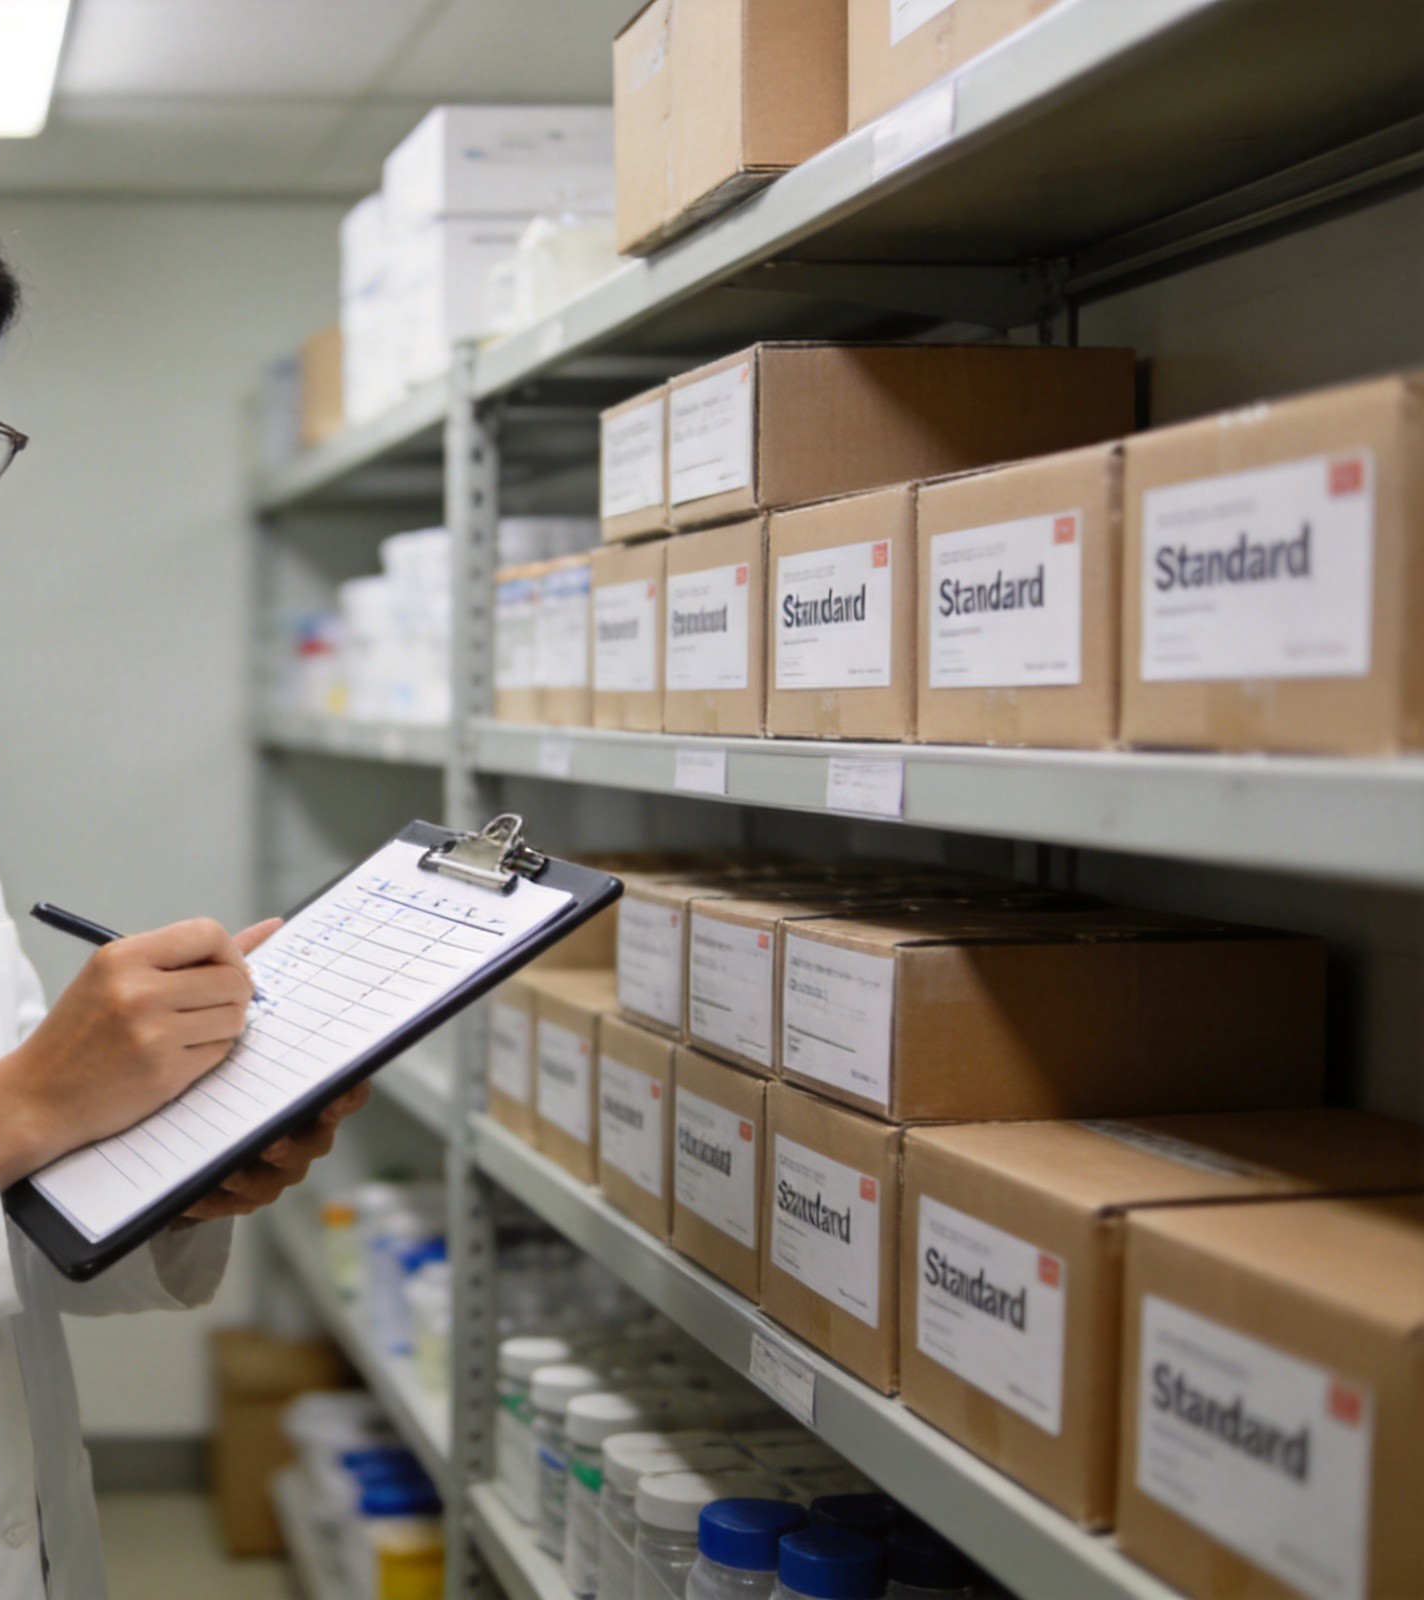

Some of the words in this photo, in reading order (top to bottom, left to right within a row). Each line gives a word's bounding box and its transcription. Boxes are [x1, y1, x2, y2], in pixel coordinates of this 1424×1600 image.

[939, 563, 1044, 617] Standard
[1155, 518, 1311, 591] Standard
[925, 1247, 1026, 1331] Standard
